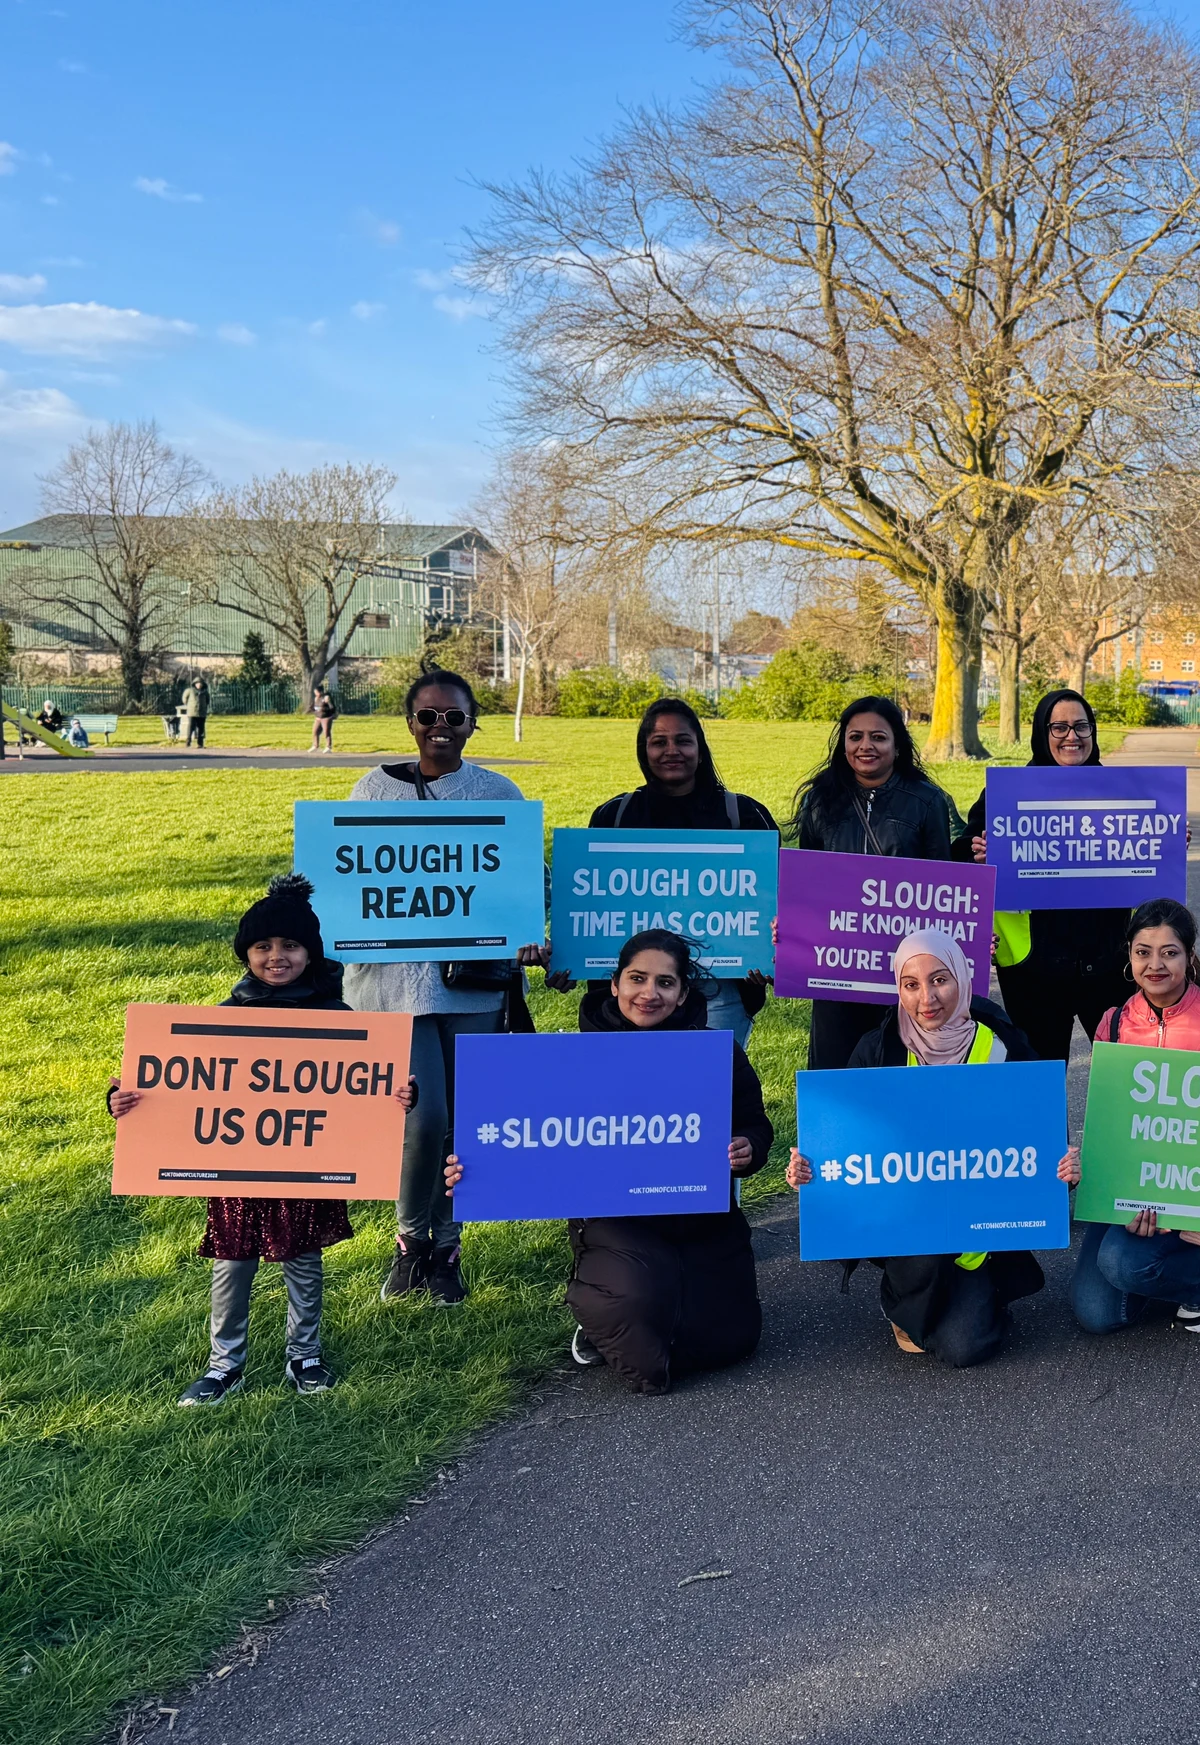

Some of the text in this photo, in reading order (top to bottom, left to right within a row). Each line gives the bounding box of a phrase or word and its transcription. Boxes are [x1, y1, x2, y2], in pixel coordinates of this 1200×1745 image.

[992, 814, 1181, 838] SLOUGH & STEADY
[335, 844, 500, 874] SLOUGH IS
[1011, 838, 1162, 862] WINS THE RACE
[572, 868, 757, 896] SLOUGH OUR
[860, 878, 980, 914] SLOUGH:
[362, 885, 476, 919] READY
[570, 911, 760, 937] TIME HAS COME
[830, 910, 978, 942] WE KNOW WHAT
[814, 946, 883, 971] YOU'RE
[137, 1055, 394, 1096] DONT SLOUGH
[194, 1106, 327, 1147] US OFF
[476, 1112, 701, 1148] #SLOUGH2028
[1130, 1114, 1199, 1145] MORE
[820, 1146, 1037, 1186] #SLOUGH2028
[629, 1185, 707, 1194] #UKTOWNOFCULTURE2028
[970, 1220, 1046, 1230] #UKTOWNOFCULTURE2028
[302, 1357, 321, 1370] NIKE
